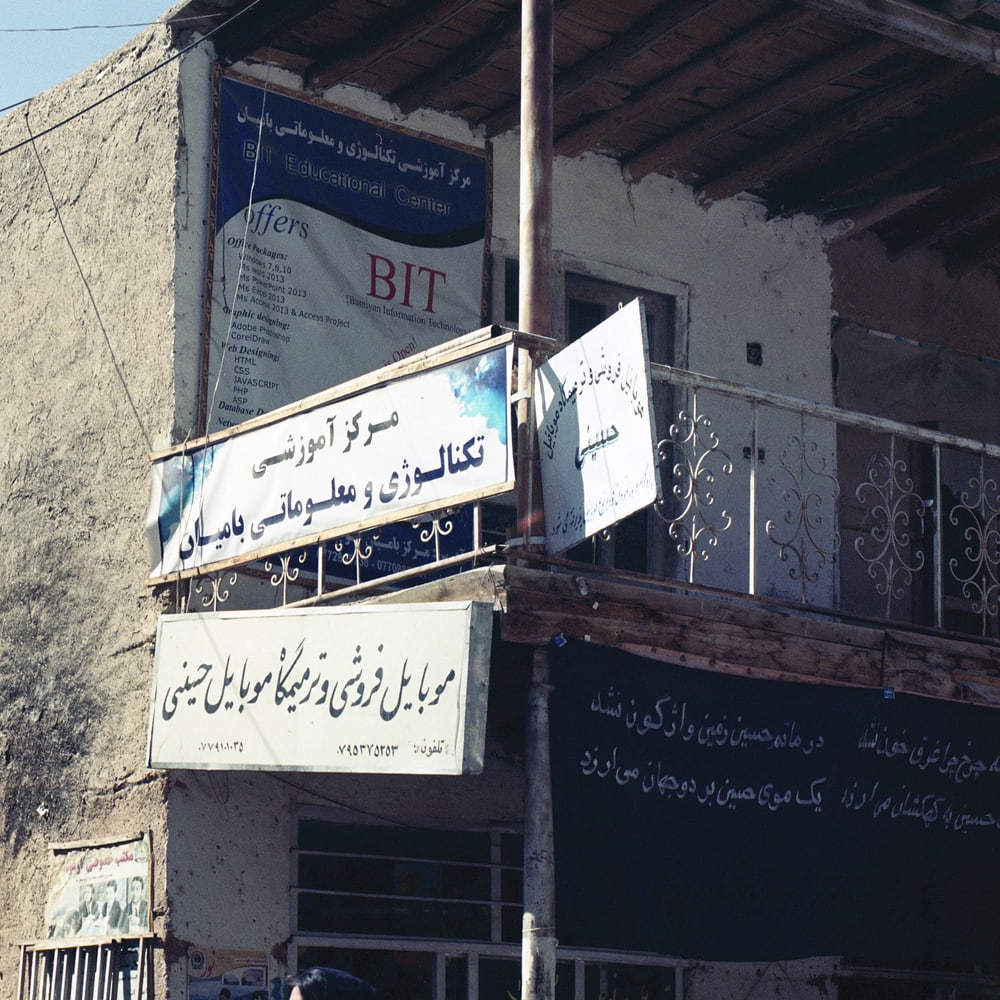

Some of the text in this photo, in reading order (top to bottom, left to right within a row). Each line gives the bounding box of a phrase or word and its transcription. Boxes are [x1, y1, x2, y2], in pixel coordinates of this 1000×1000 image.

[275, 120, 336, 148] معلوماتی
[398, 157, 446, 181] آموزشی
[448, 167, 472, 189] مرکز
[286, 153, 386, 200] Educational
[395, 184, 451, 216] Center
[252, 243, 288, 261] Packages:
[266, 272, 285, 283] 2013
[365, 252, 447, 314] BIT
[268, 292, 285, 304] 2013
[287, 287, 307, 299] 2013
[231, 320, 258, 332] Adobe
[271, 303, 289, 315] 2013
[299, 310, 324, 322] Access
[325, 314, 350, 328] Project
[383, 305, 426, 326] Information
[233, 365, 251, 376] CSS
[234, 356, 257, 366] HTML
[233, 385, 250, 396] PHP
[234, 376, 280, 391] JAVASCRIPT
[218, 401, 254, 416] Database
[232, 396, 248, 406] ASP
[252, 408, 399, 479] مرکز آموزشی
[574, 424, 620, 470] حسینی
[179, 435, 485, 561] تکنالوژی و معلوماتی بامیان
[161, 659, 213, 721] حسینی
[203, 654, 273, 714] موبایل
[329, 643, 384, 718] فروشی
[379, 657, 456, 721] موبایل
[697, 712, 729, 748] زمین
[730, 715, 774, 748] حسین
[767, 719, 802, 751] ماتم
[803, 735, 825, 756] در
[697, 779, 716, 807] بر
[716, 777, 758, 812] حسین
[757, 782, 792, 812] موی
[795, 776, 828, 814] یک
[953, 802, 996, 834] حسین
